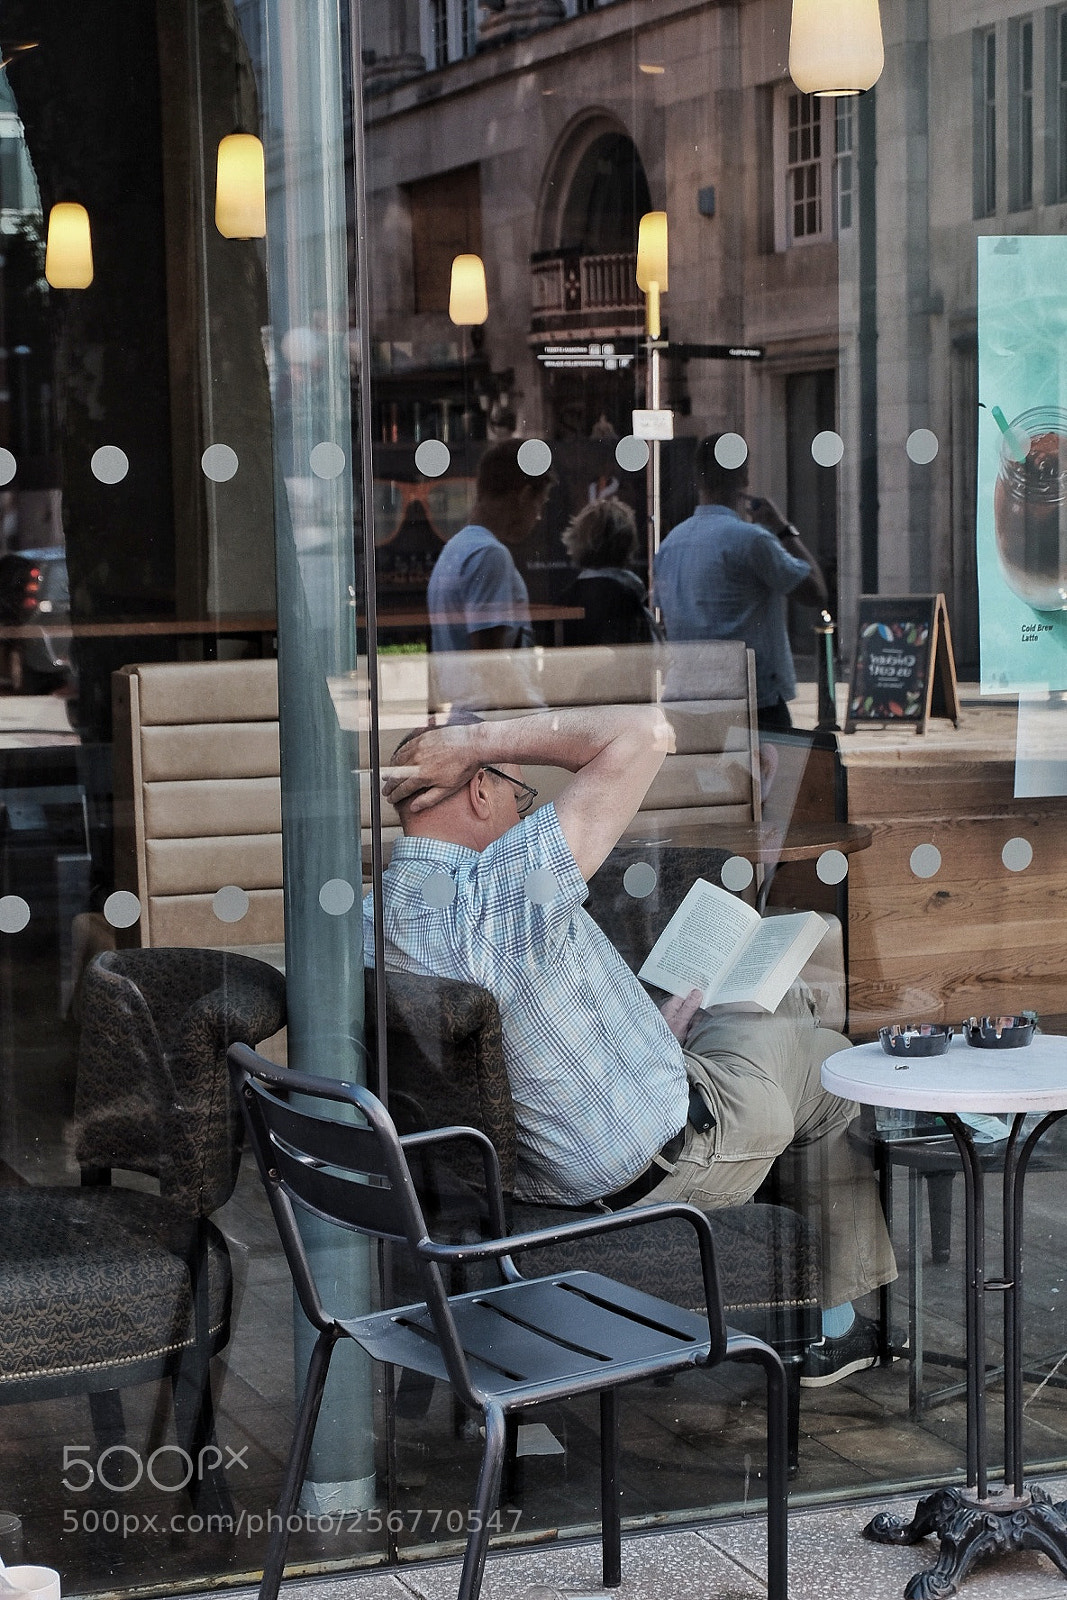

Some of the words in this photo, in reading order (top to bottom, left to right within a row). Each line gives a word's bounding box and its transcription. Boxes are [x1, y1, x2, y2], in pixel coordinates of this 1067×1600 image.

[1021, 624, 1037, 632] Cold
[1037, 624, 1053, 632] Brew
[1021, 634, 1038, 642] Latte
